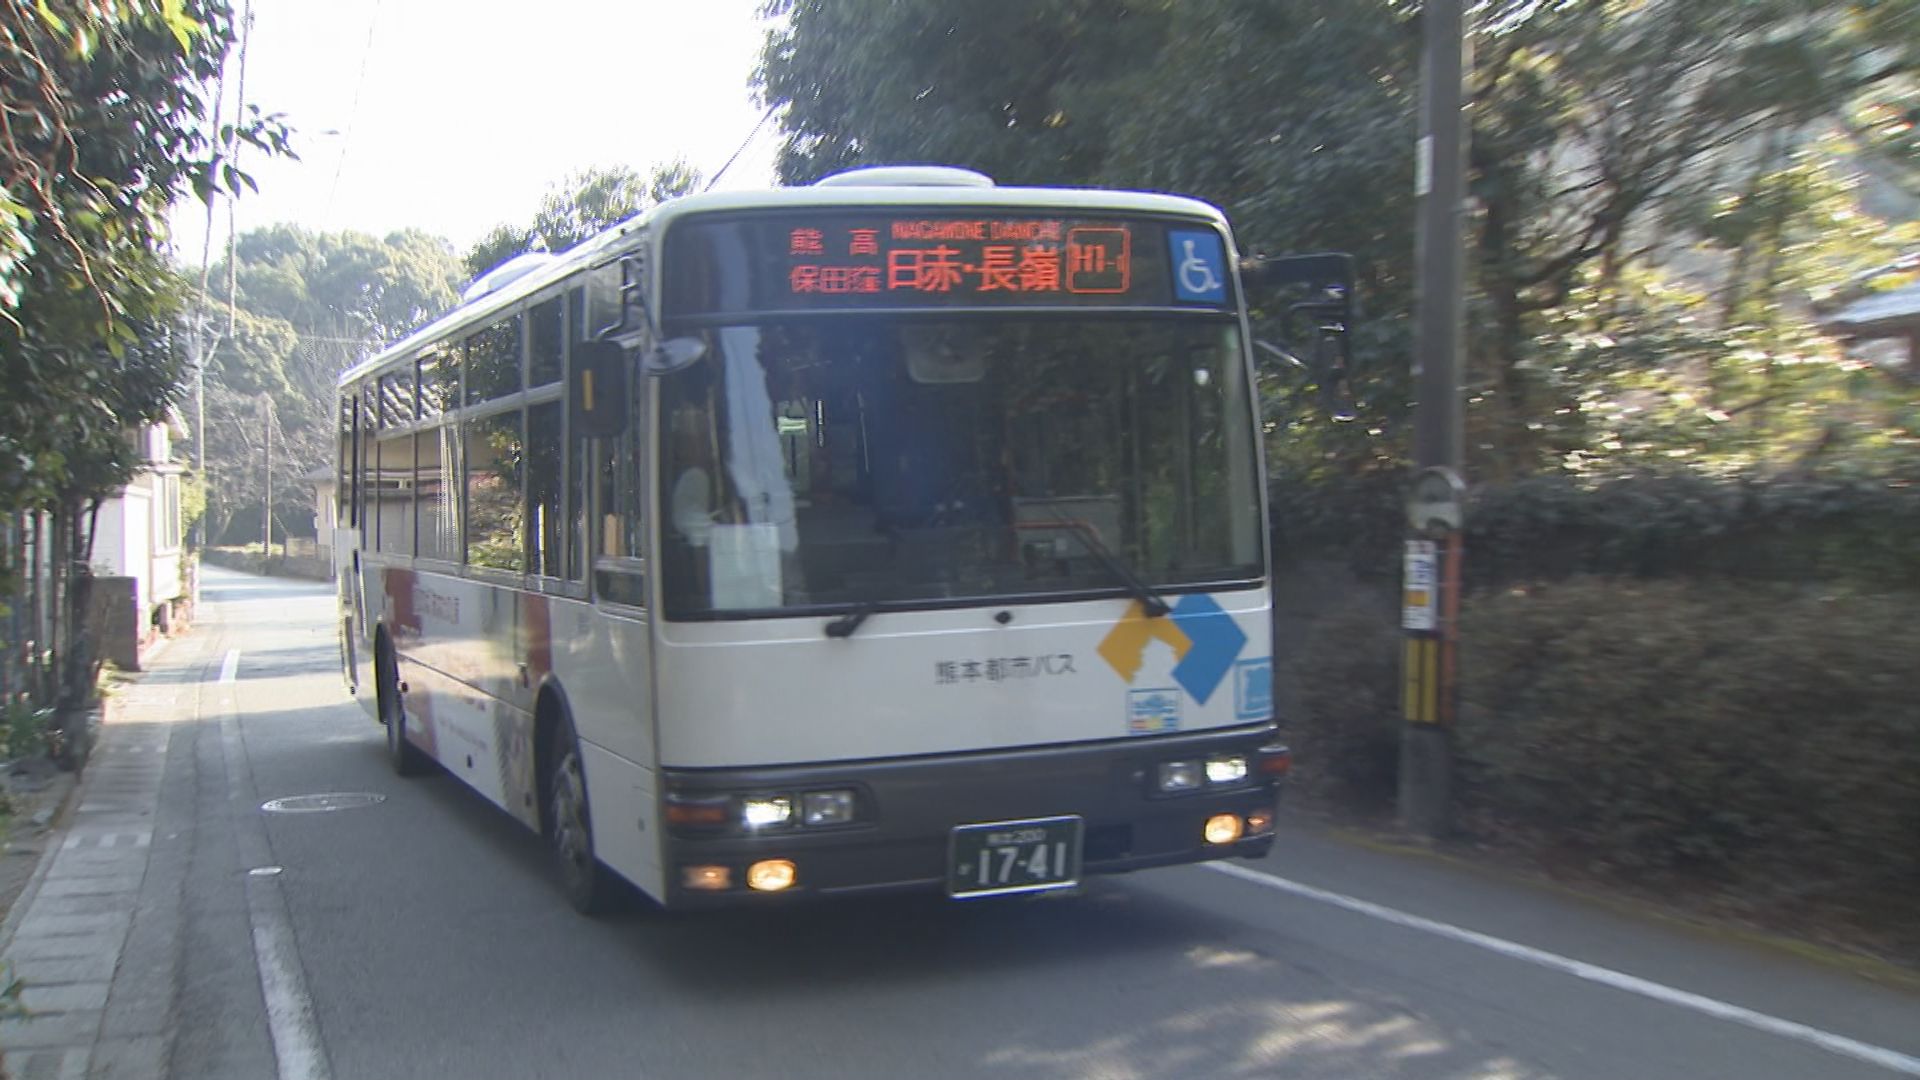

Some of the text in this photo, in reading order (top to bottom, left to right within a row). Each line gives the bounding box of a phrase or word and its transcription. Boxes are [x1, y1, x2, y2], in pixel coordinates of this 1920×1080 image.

[935, 653, 1076, 684] 熊本都市バス
[978, 842, 1067, 885] 17-41
